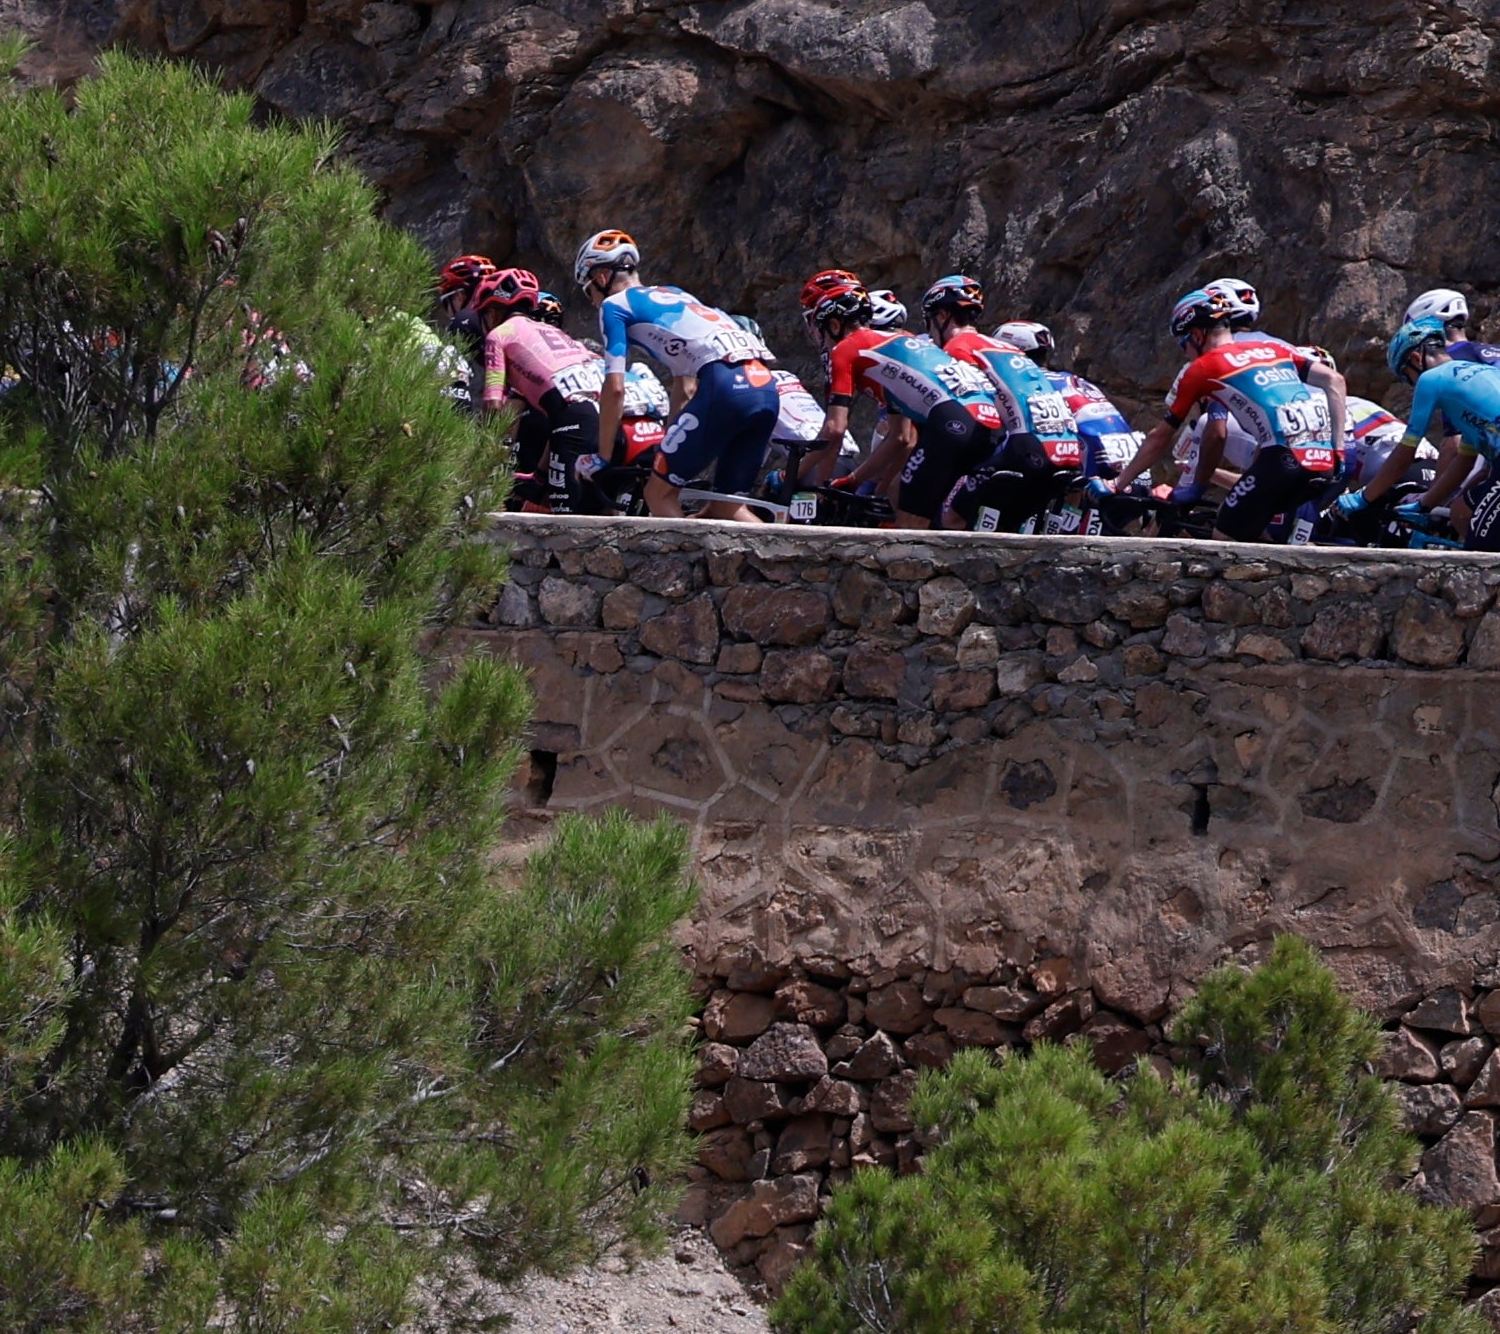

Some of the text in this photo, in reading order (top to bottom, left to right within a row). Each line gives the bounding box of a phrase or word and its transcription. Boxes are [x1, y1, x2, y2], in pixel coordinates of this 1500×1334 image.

[712, 330, 747, 353] 176
[899, 371, 929, 397] SOLAR
[1245, 405, 1265, 436] SOLAR
[1056, 443, 1080, 456] CAPS
[1304, 449, 1332, 461] CAPS
[795, 501, 814, 517] 176
[982, 514, 997, 530] 97
[1294, 527, 1308, 543] 91
